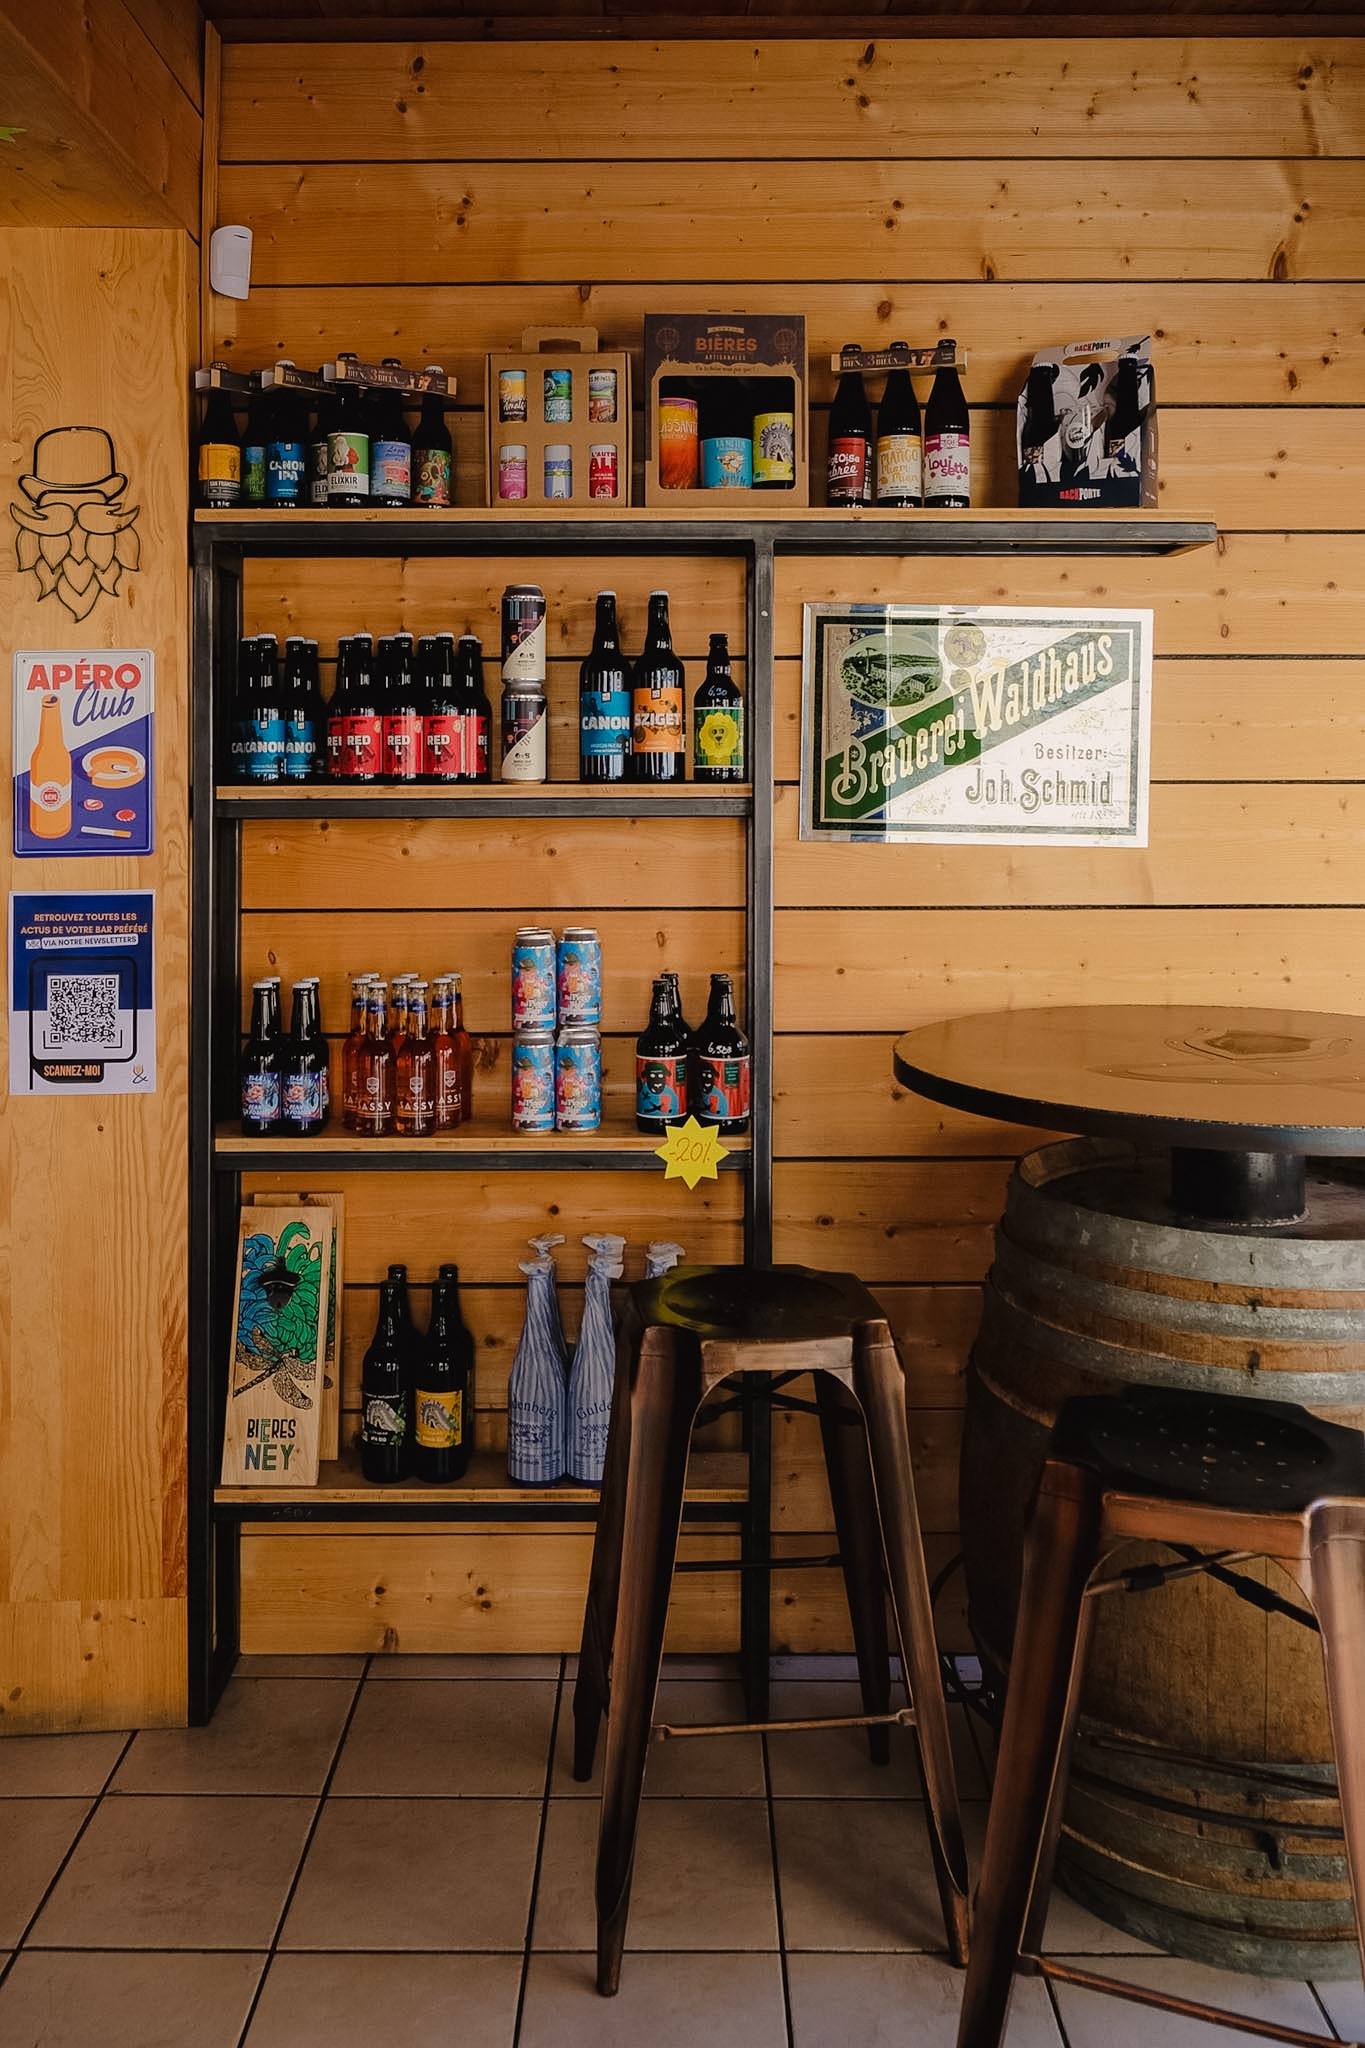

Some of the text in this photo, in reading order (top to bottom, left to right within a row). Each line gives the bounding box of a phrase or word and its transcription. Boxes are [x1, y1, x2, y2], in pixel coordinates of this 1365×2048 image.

[695, 333, 758, 351] BIÈRES
[269, 461, 305, 471] CANON
[278, 471, 299, 481] IPA
[315, 485, 328, 493] ELIX
[27, 658, 142, 691] APÉRO
[72, 680, 135, 727] Club
[581, 715, 630, 730] CANON
[830, 634, 1114, 806] Brauerei Waldhaus
[347, 735, 372, 746] RED
[387, 735, 411, 746] RED
[427, 734, 450, 746] RED
[285, 741, 317, 754] ANO
[965, 767, 1115, 814] Joh. Schmid
[34, 912, 137, 922] RETROUVEZ TOUTES LES
[20, 922, 149, 935] ACTUS DE VOTRE BAR PRÉFÉRÉ
[43, 939, 57, 947] VIA
[58, 938, 84, 947] NOTRE
[43, 1064, 101, 1077] SCANNEZ-MOI
[244, 1443, 295, 1471] NEY
